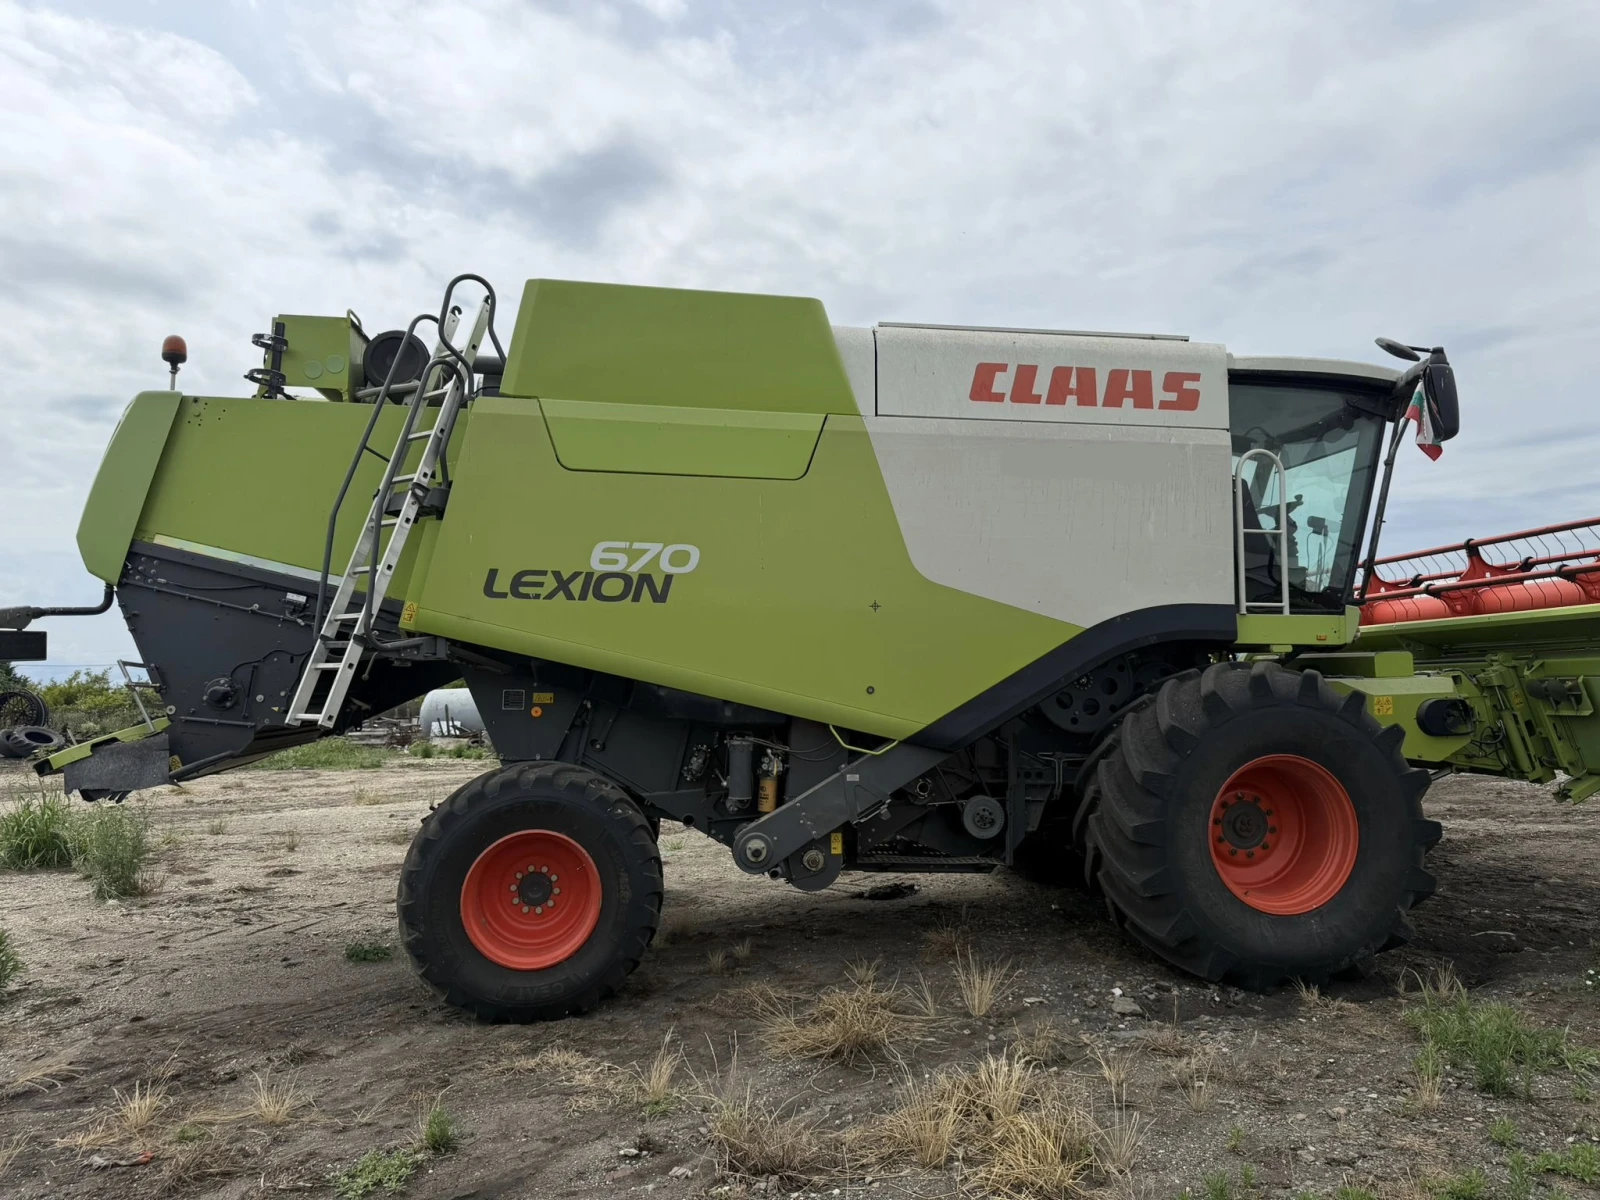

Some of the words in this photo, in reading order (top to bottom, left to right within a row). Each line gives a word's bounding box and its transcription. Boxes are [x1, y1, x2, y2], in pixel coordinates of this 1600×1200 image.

[969, 362, 1202, 412] CLAAS
[589, 541, 701, 574] 670
[483, 568, 674, 604] LEXION
